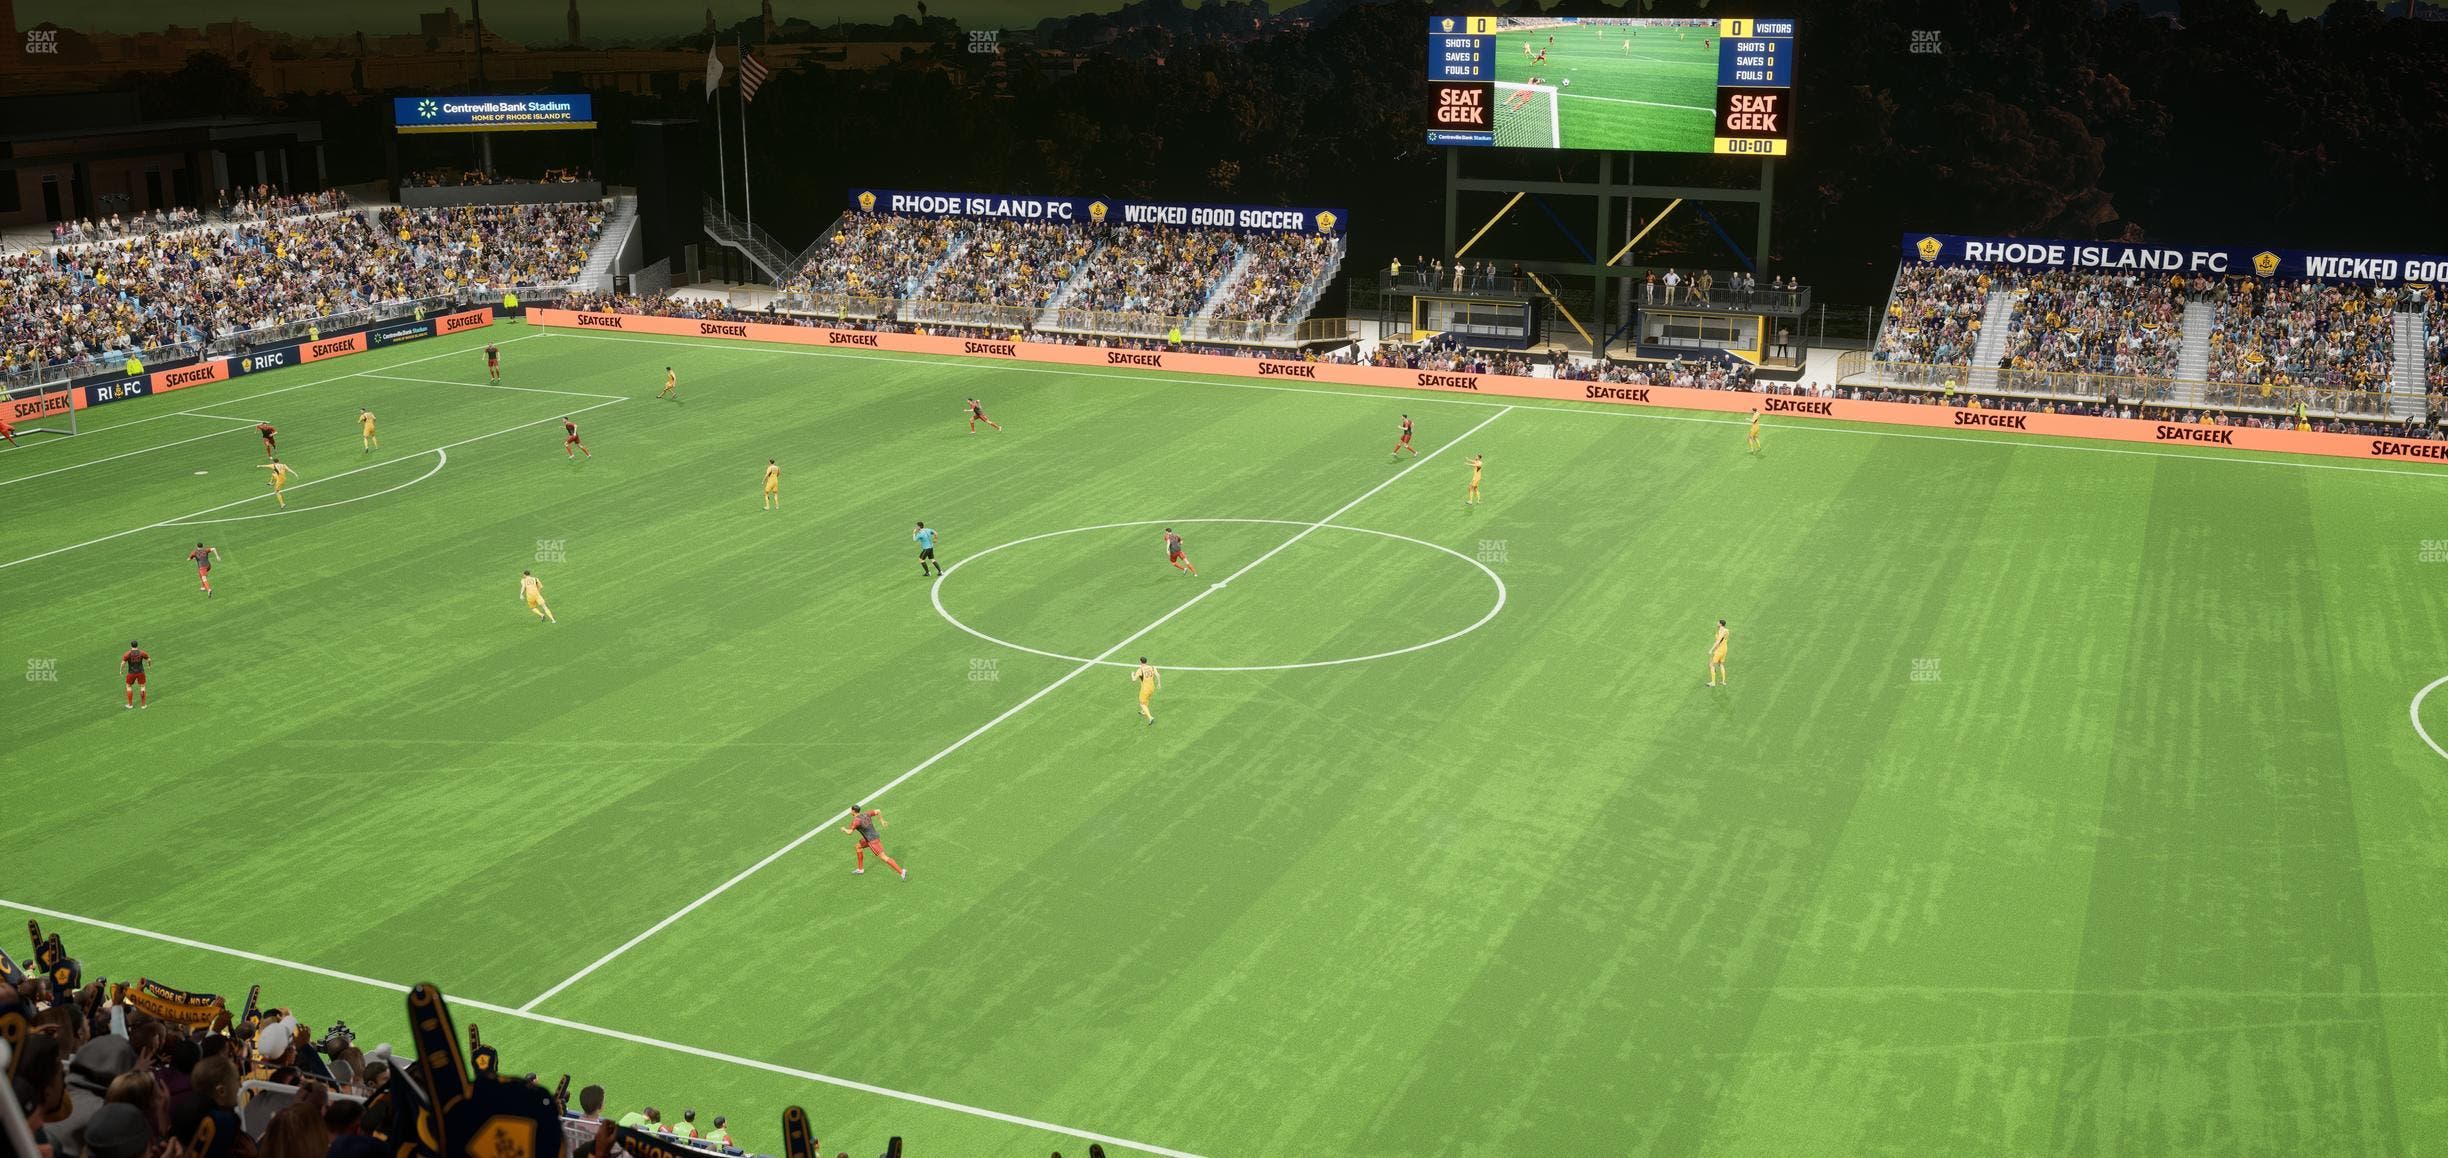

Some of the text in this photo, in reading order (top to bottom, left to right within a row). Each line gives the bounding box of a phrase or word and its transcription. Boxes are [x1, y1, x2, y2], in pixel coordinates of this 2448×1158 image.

[1478, 18, 1486, 33] 0
[1732, 20, 1741, 36] 0
[1756, 23, 1792, 33] VISITORS
[1445, 39, 1480, 48] SHOTS 0
[1737, 43, 1775, 52] SHOTS 0
[1445, 52, 1479, 61] SAVES 0
[1737, 57, 1774, 66] SAVES 0
[1445, 66, 1479, 75] FOULS 0
[1736, 71, 1773, 80] FOULS 0
[1440, 88, 1482, 106] SEAT
[1730, 94, 1777, 113] SEAT
[528, 101, 571, 111] Stadium
[1437, 106, 1484, 124] GEEK
[1726, 113, 1777, 132] GEEK
[1728, 140, 1772, 153] 00:00
[892, 195, 1073, 220] RHODE ISLAND FC
[1125, 204, 1304, 230] WICKED GOOD SOCCER
[1965, 241, 2228, 273] RHODE ISLAND FC
[2306, 256, 2398, 281] WICKED
[447, 313, 484, 331] SEATGEEK
[577, 314, 623, 329] SEATGEEK
[700, 322, 748, 338] SEATGEEK
[829, 331, 878, 347] SEATGEEK
[312, 338, 355, 358] SEATGEEK
[965, 341, 1016, 357] SEATGEEK
[255, 353, 284, 370] RIFC
[1108, 351, 1162, 368] SEATGEEK
[166, 366, 215, 388] SEATGEEK
[1258, 362, 1316, 379] SEATGEEK
[1418, 373, 1478, 390] SEATGEEK
[1586, 385, 1650, 402] SEATGEEK
[1765, 397, 1832, 416] SEATGEEK
[1954, 411, 2026, 430] SEATGEEK
[2156, 425, 2233, 445] SEATGEEK
[149, 984, 175, 1001] RHODE
[130, 994, 164, 1017] RHODE
[165, 1008, 199, 1022] ISLAND
